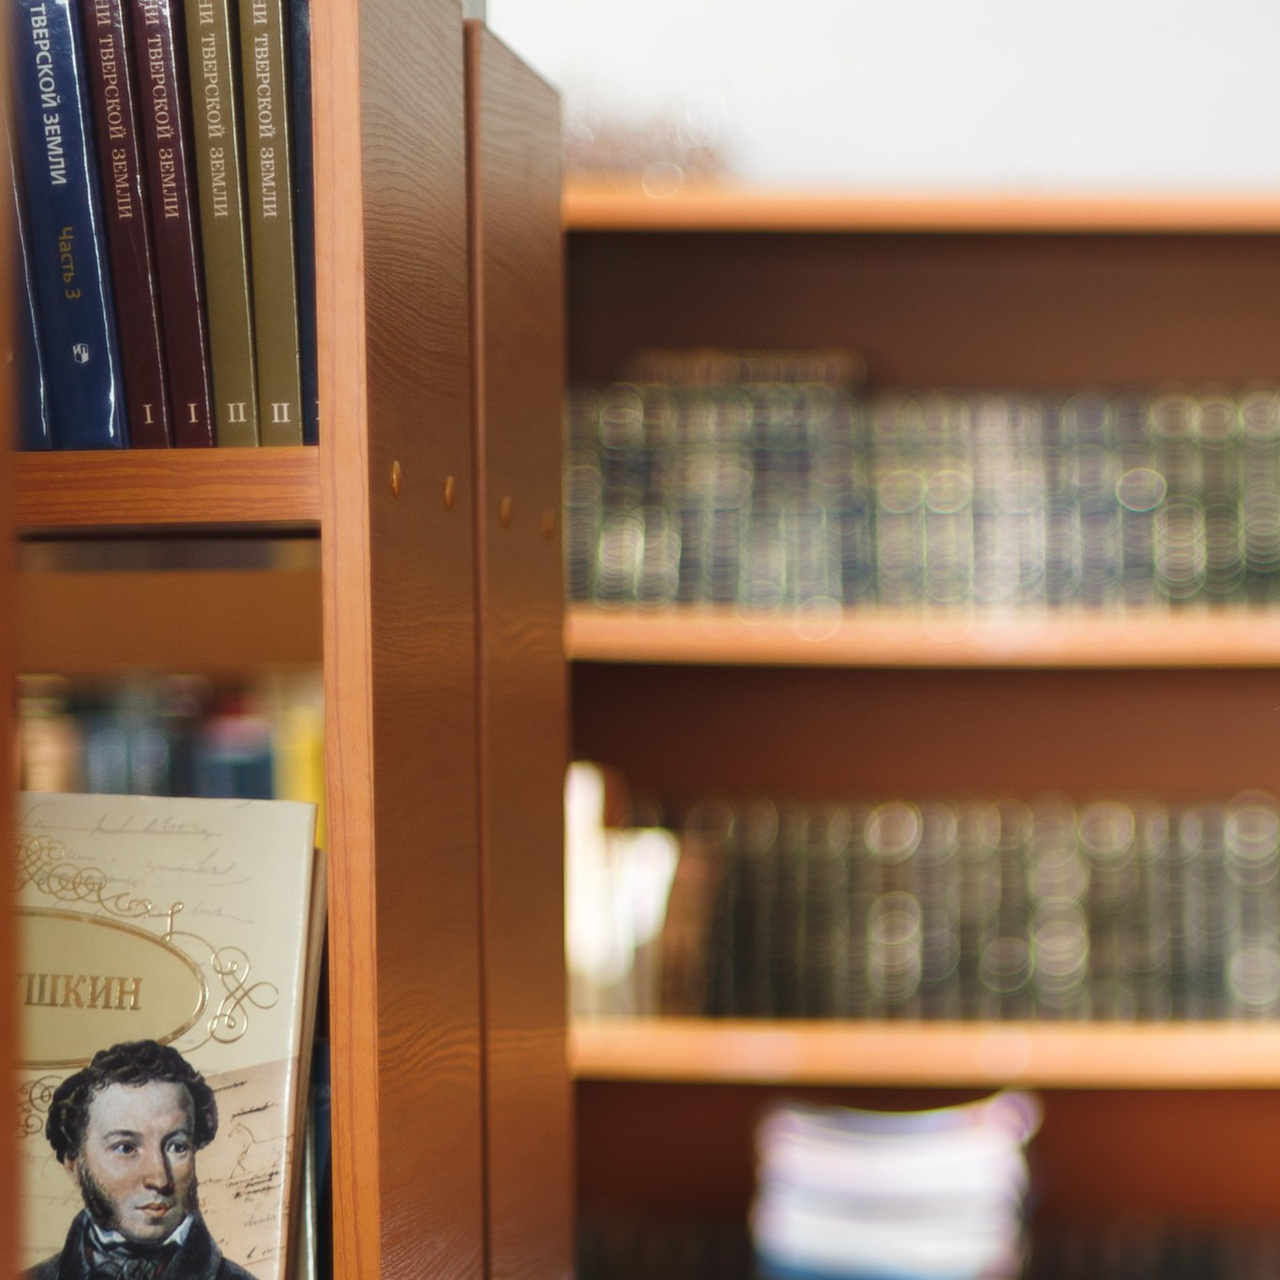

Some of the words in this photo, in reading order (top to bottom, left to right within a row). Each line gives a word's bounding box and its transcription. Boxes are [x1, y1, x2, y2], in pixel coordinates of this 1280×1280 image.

[28, 2, 60, 107] ТВЕРСКОЙ
[99, 33, 128, 140] ТВЕРСКОЙ
[146, 33, 175, 140] ТВЕРСКОЙ
[200, 33, 226, 140] ТВЕРСКОЙ
[253, 33, 278, 140] ТВЕРСКОЙ
[43, 114, 68, 186] ЗЕМЛИ
[111, 148, 133, 220] ЗЕМЛИ
[157, 148, 180, 219] ЗЕМЛИ
[208, 147, 229, 218] ЗЕМЛИ
[260, 147, 278, 218] ЗЕМЛИ
[58, 225, 78, 284] Часть
[65, 288, 81, 300] 3
[142, 403, 155, 425] I
[187, 402, 199, 424] I
[226, 402, 248, 424] II
[270, 402, 292, 424] II
